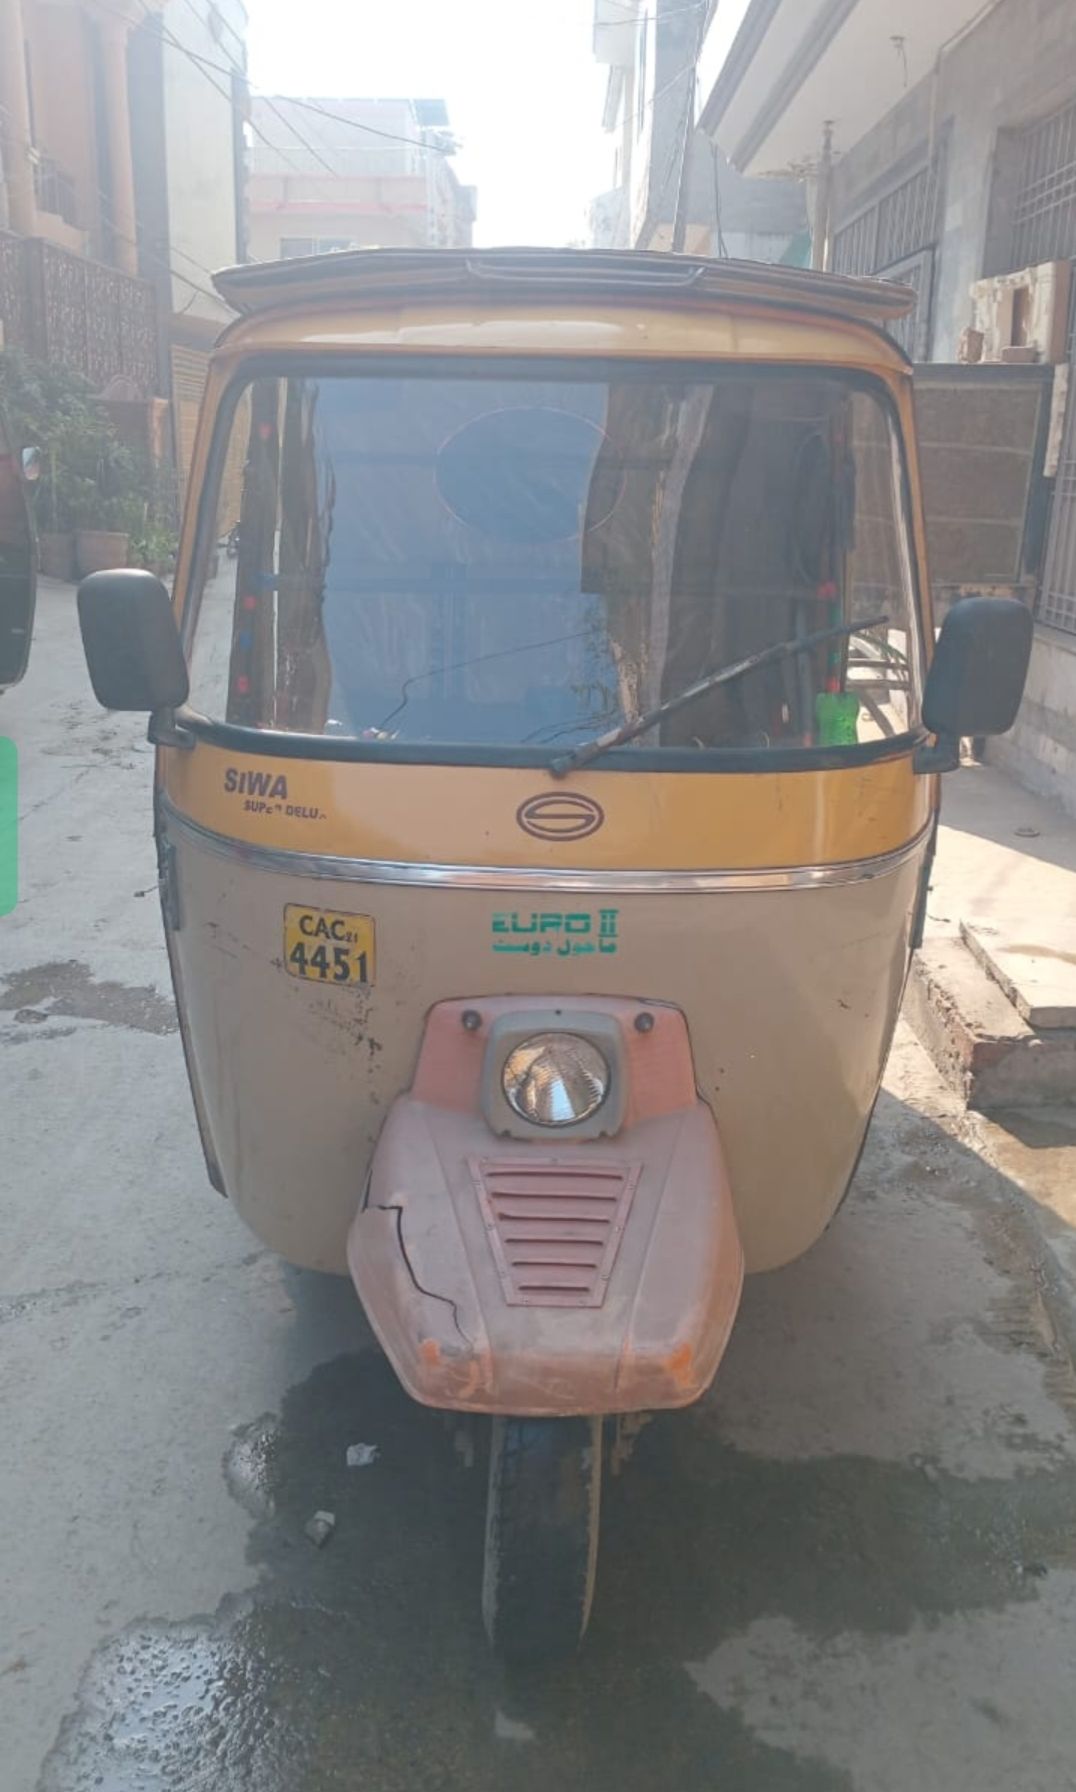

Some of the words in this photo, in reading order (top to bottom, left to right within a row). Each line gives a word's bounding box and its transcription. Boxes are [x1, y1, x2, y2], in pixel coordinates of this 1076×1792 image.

[224, 767, 288, 799] SIWA
[285, 804, 327, 820] DELU
[299, 915, 345, 941] CAC
[492, 912, 591, 933] EURO
[290, 942, 367, 983] 4451
